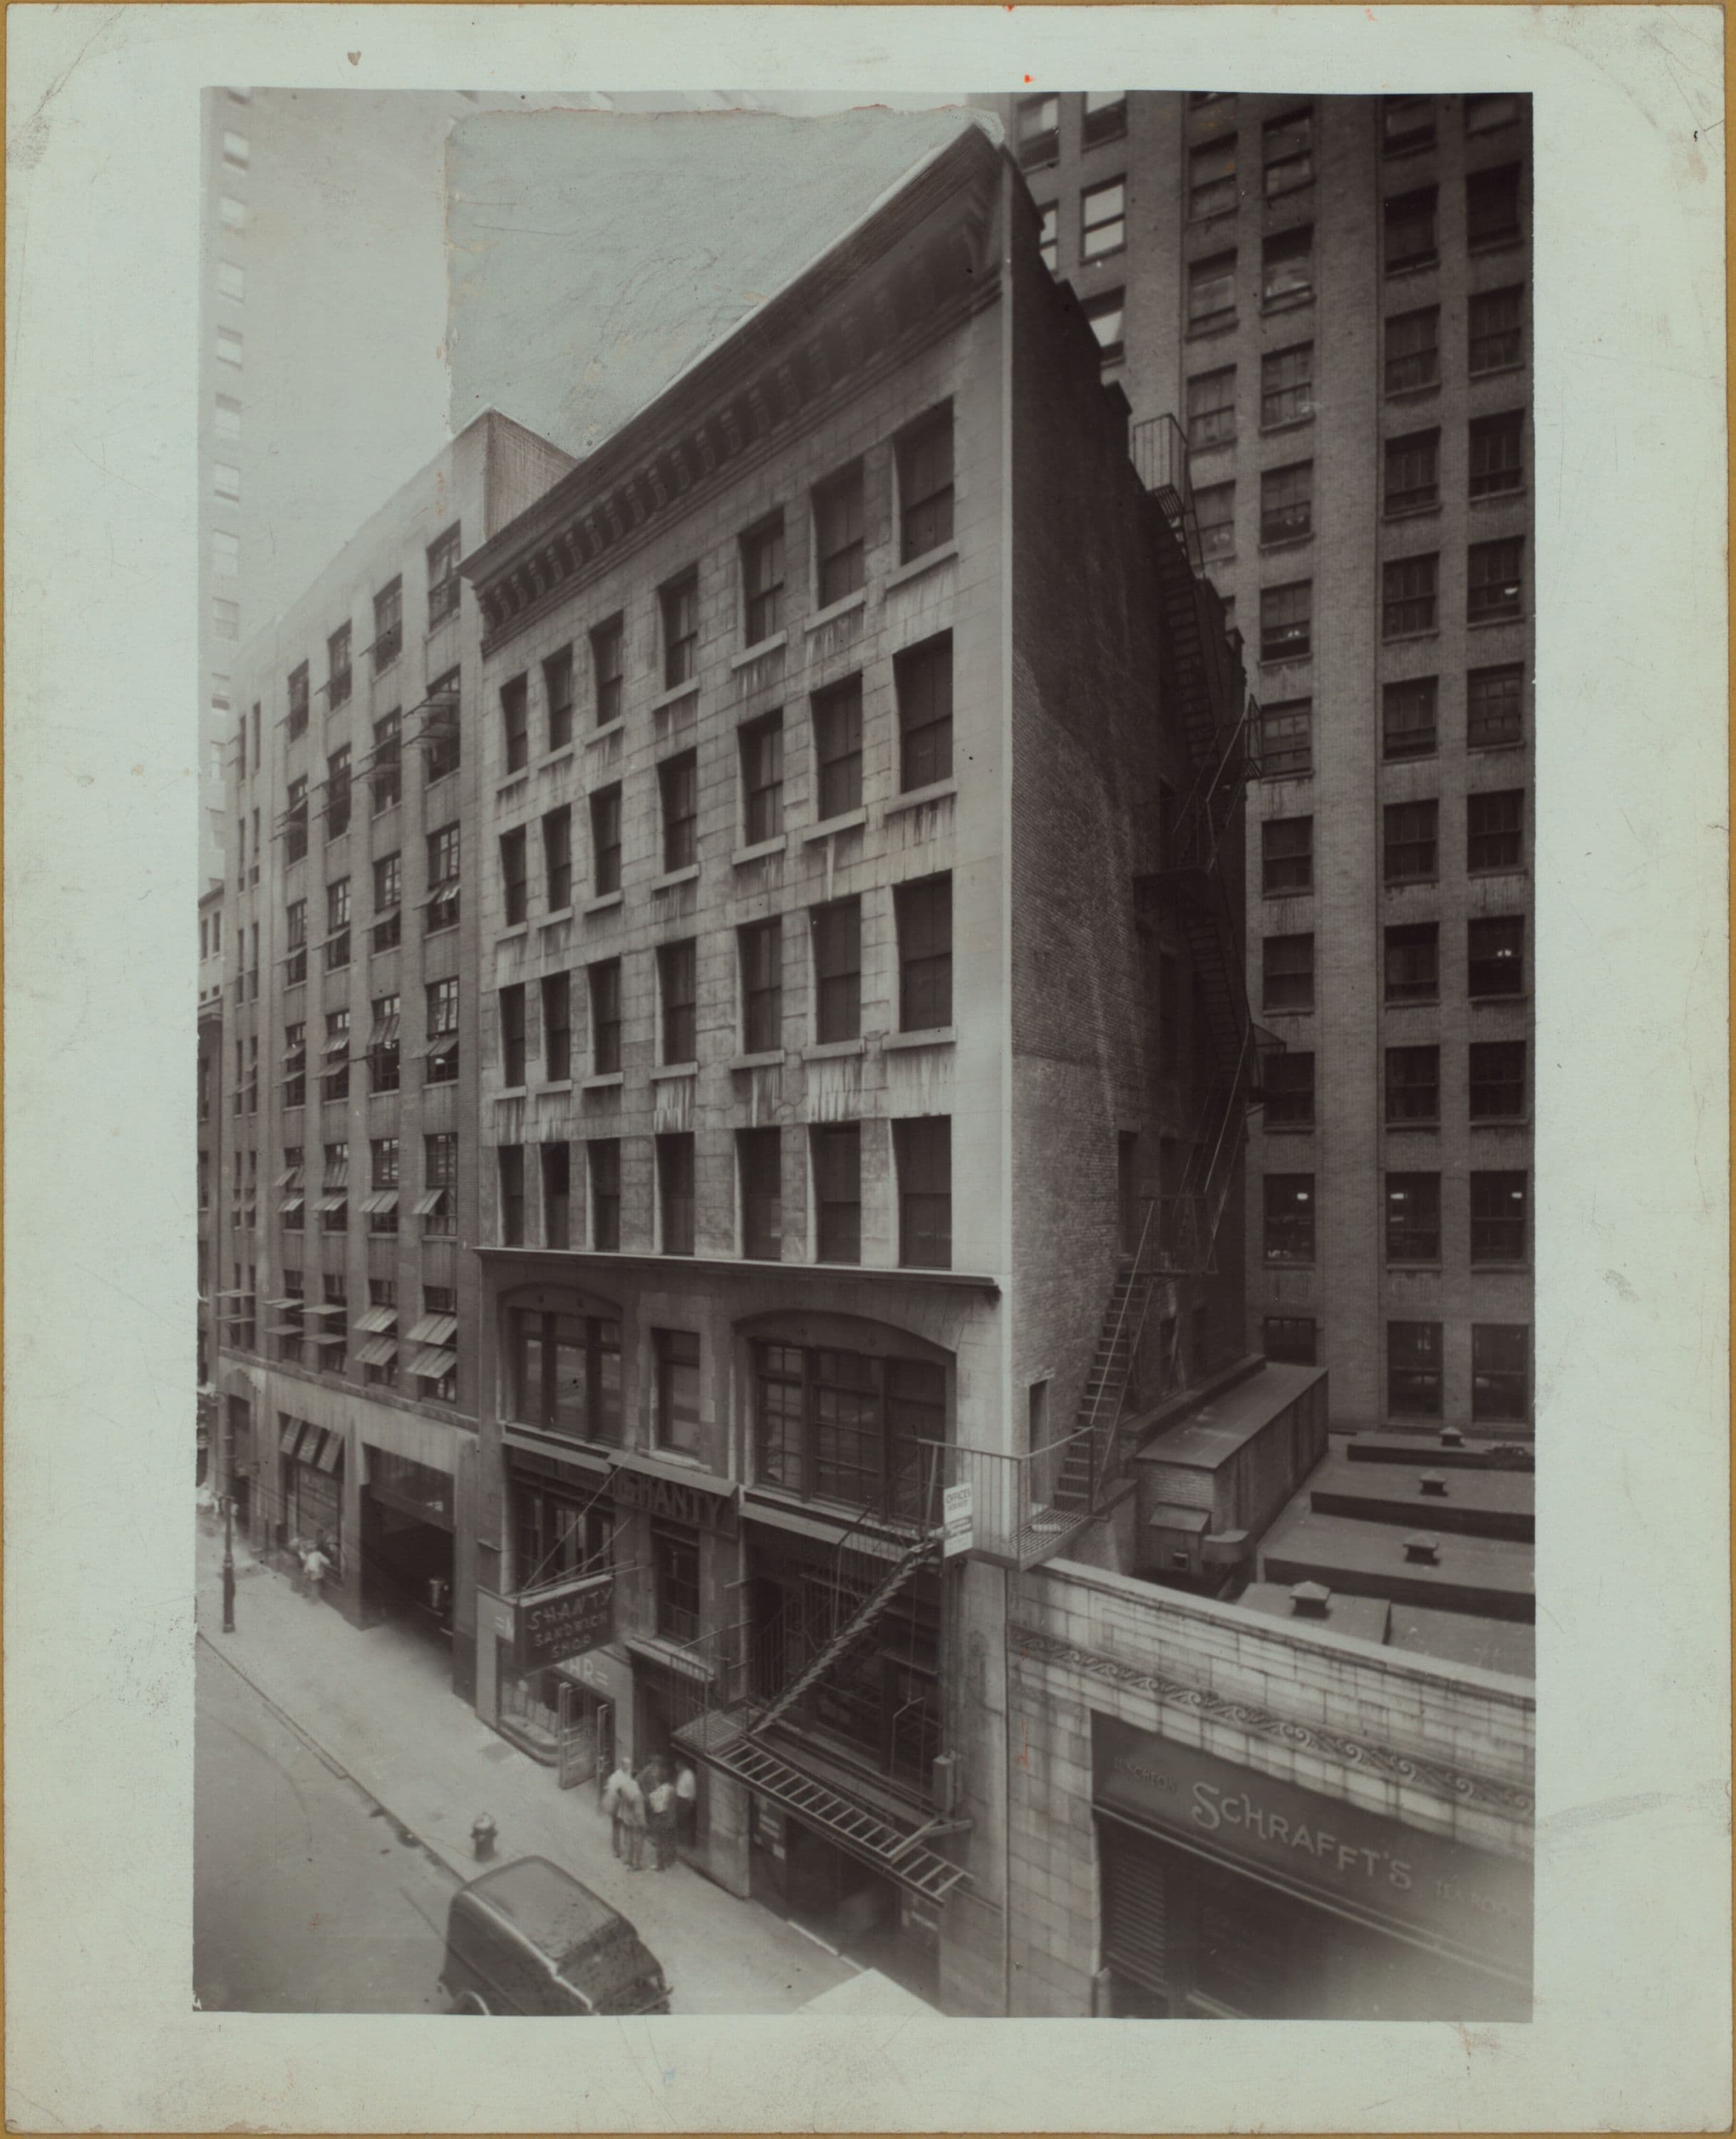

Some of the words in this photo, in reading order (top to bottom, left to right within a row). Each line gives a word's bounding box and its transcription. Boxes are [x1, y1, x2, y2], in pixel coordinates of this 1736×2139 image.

[527, 1587, 614, 1630] SHANTY
[534, 1610, 608, 1647] SANDWICH
[550, 1634, 591, 1659] SHOP
